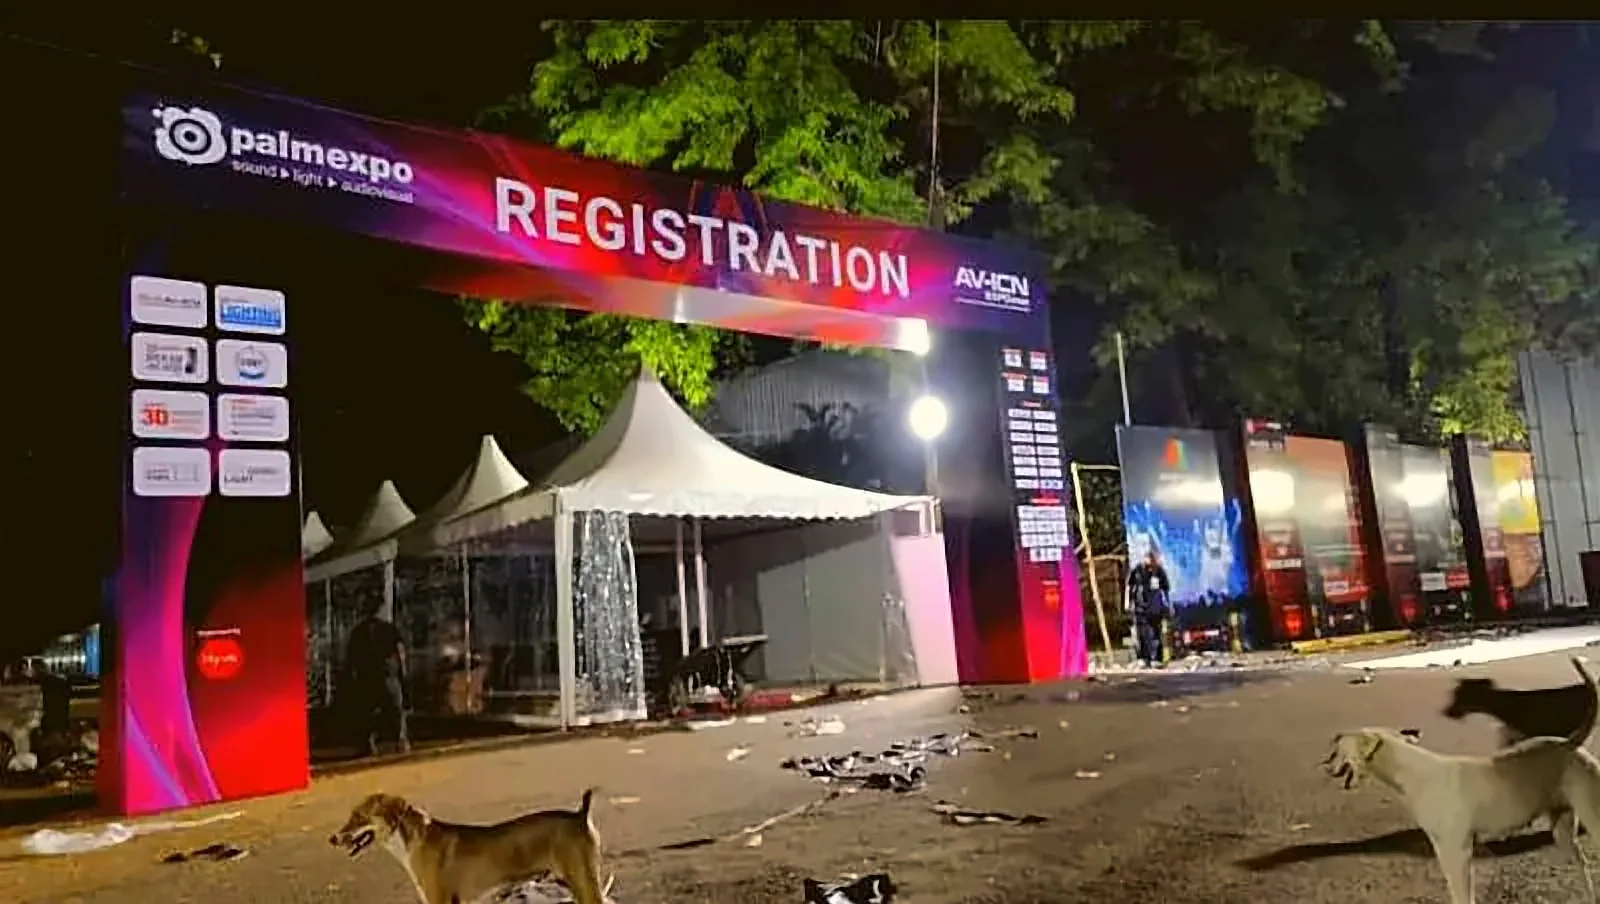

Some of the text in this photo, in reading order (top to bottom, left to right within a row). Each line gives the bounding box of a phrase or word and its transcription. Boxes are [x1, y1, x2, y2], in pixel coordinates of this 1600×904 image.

[230, 126, 414, 184] palmexpo
[231, 160, 278, 178] sound
[292, 168, 324, 188] light
[495, 176, 911, 298] REGISTRATION
[954, 266, 1030, 297] AV-ICN
